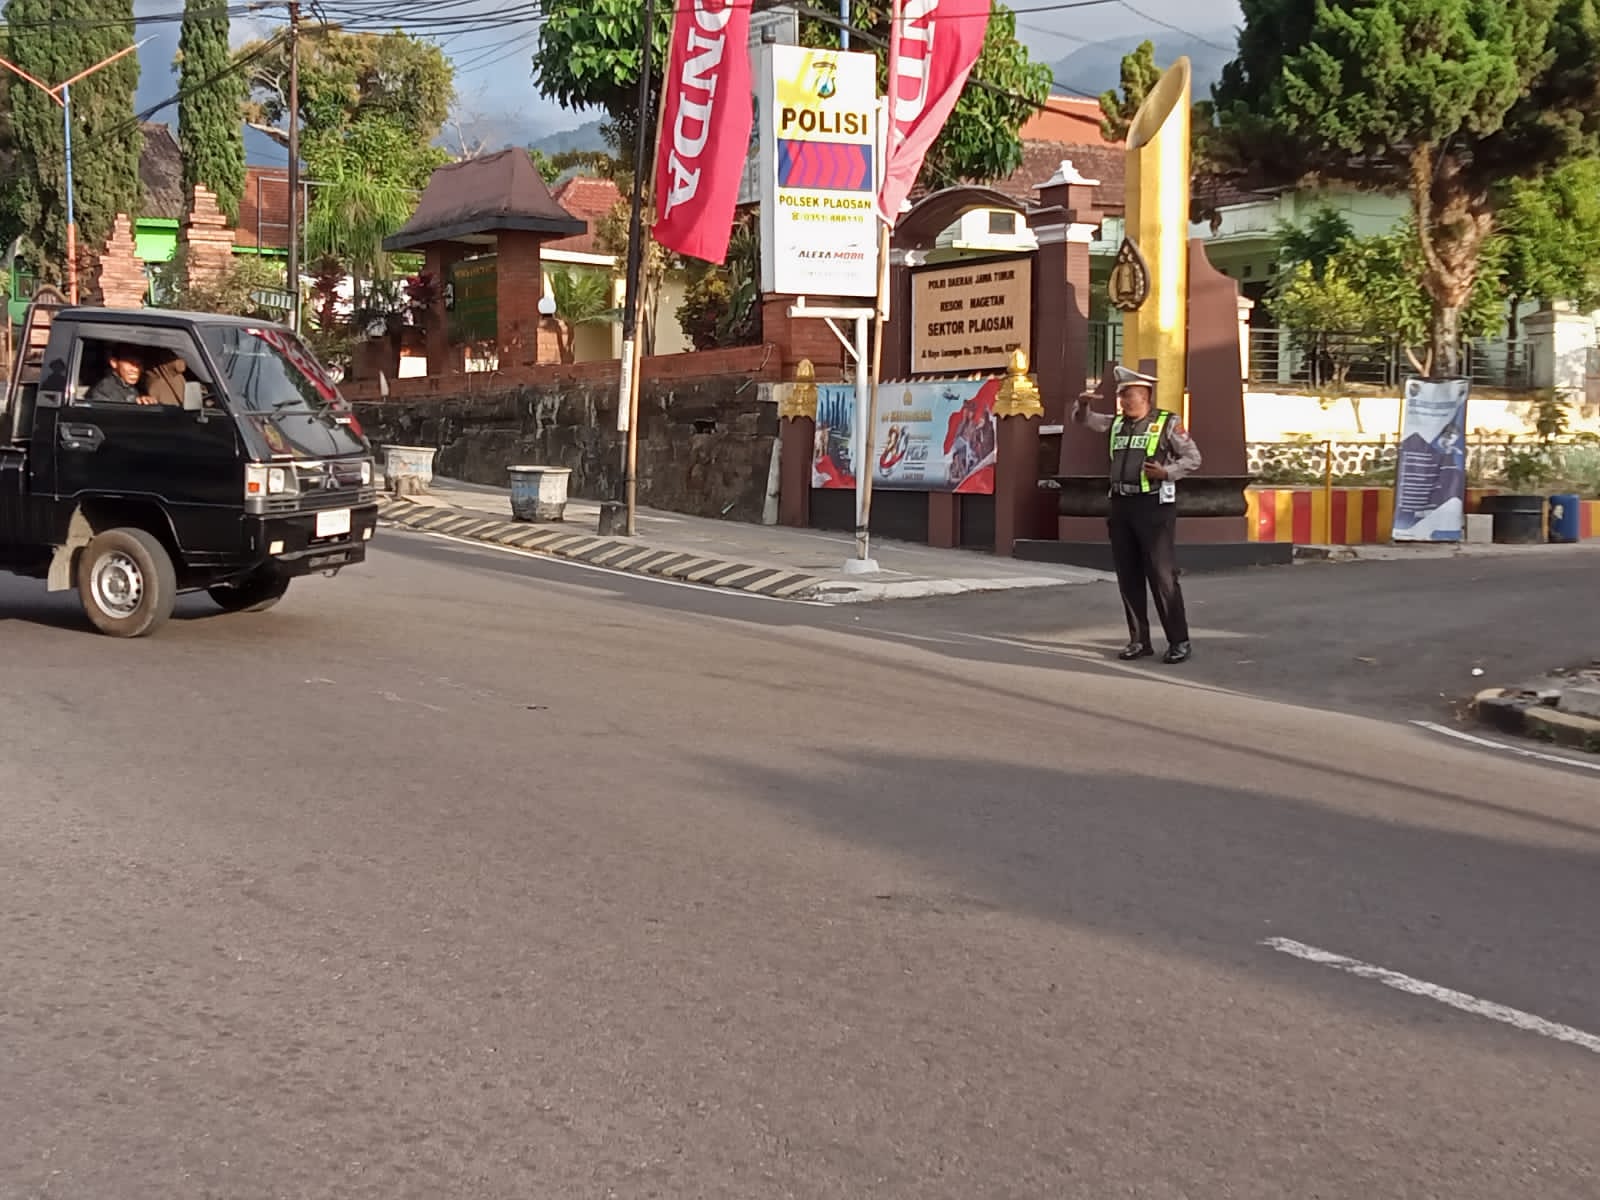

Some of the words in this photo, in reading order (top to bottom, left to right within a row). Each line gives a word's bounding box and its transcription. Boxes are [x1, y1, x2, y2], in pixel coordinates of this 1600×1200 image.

[782, 107, 867, 136] POLISI
[779, 195, 819, 208] POLSEK
[823, 198, 872, 209] PLAOSAN
[948, 275, 973, 287] DAERAH
[975, 272, 992, 284] JAWA
[994, 270, 1014, 281] TIMUR
[940, 301, 963, 311] RESOR
[970, 295, 1004, 307] MAGETAN
[928, 320, 965, 336] SEKTOR
[969, 316, 1013, 332] PLAOSAN
